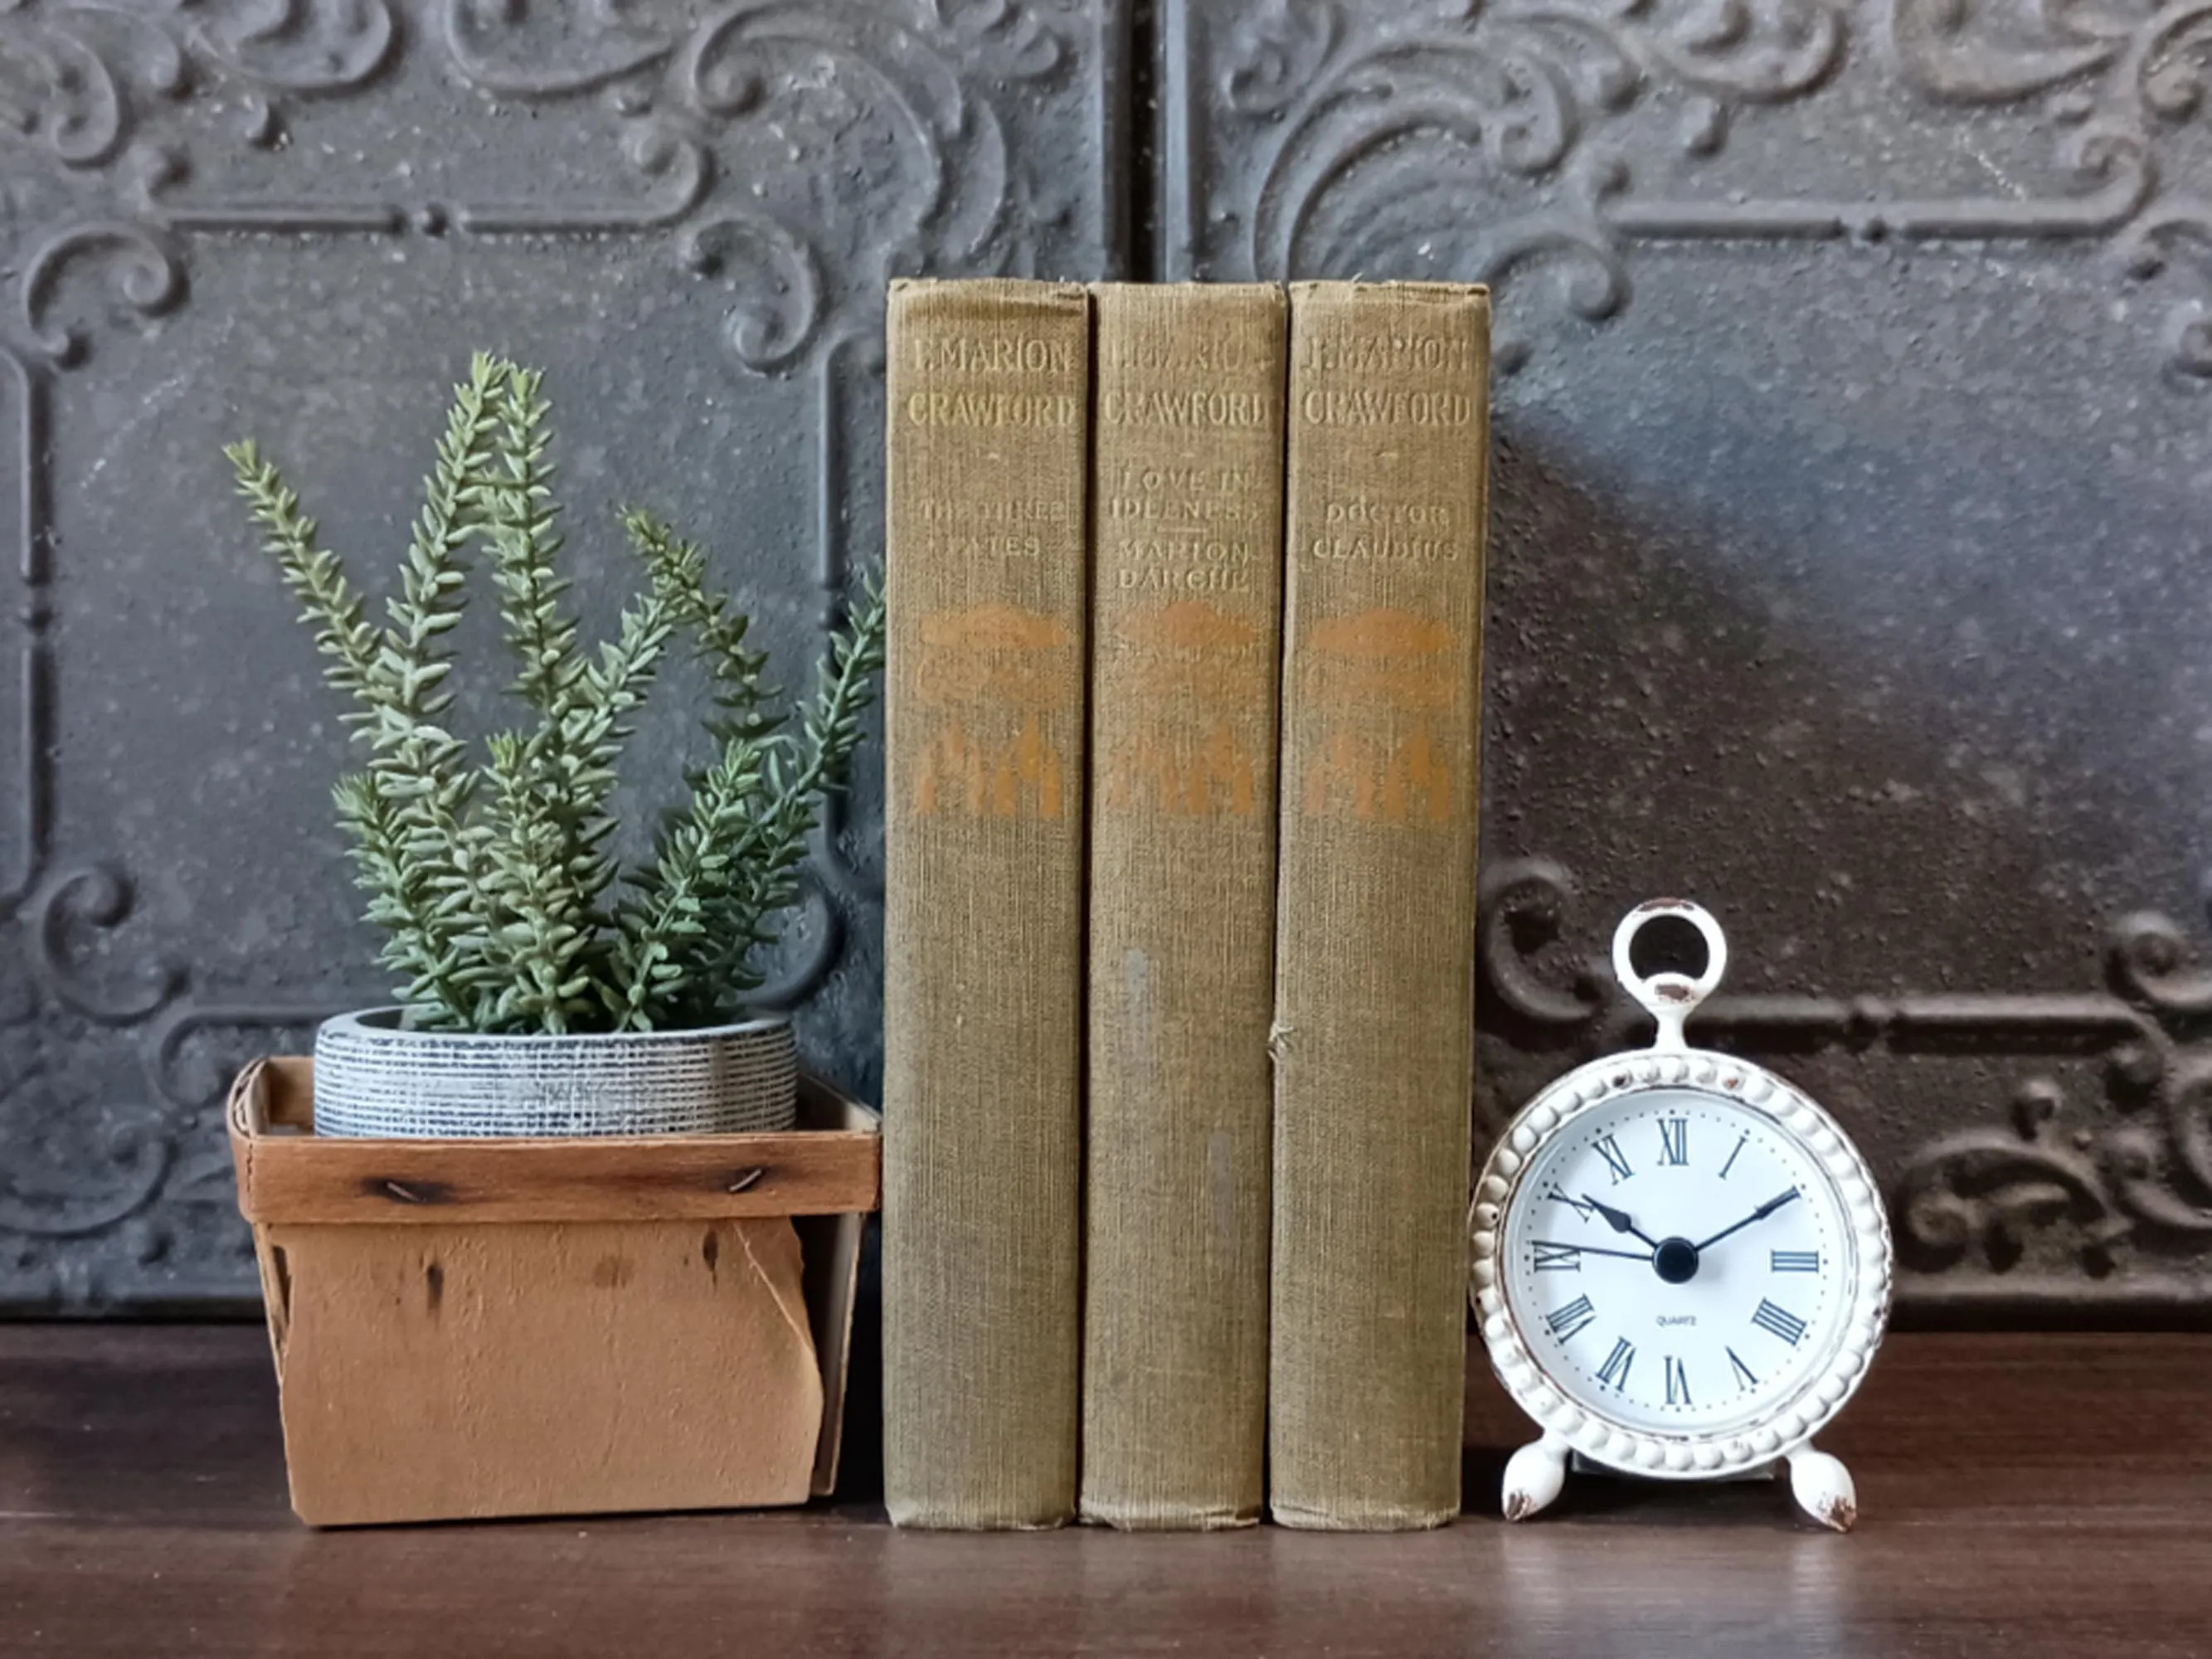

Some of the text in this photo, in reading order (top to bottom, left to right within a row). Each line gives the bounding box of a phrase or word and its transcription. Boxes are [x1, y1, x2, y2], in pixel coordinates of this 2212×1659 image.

[907, 392, 1077, 426] CRAWFORD
[1104, 391, 1268, 426] CRAWFORD
[1304, 390, 1471, 426] CRAWFORD
[1592, 1134, 1636, 1185] XI
[1657, 1119, 1689, 1165] XII
[1719, 1136, 1748, 1180] I
[1547, 1181, 1597, 1224] X
[1753, 1184, 1802, 1219] I
[1534, 1244, 1582, 1272] IX
[1771, 1250, 1819, 1272] III
[1546, 1292, 1596, 1345] VIII
[1655, 1314, 1697, 1327] QUARTZ
[1596, 1335, 1636, 1392] VII
[1664, 1355, 1693, 1404] VI
[1724, 1345, 1758, 1393] V
